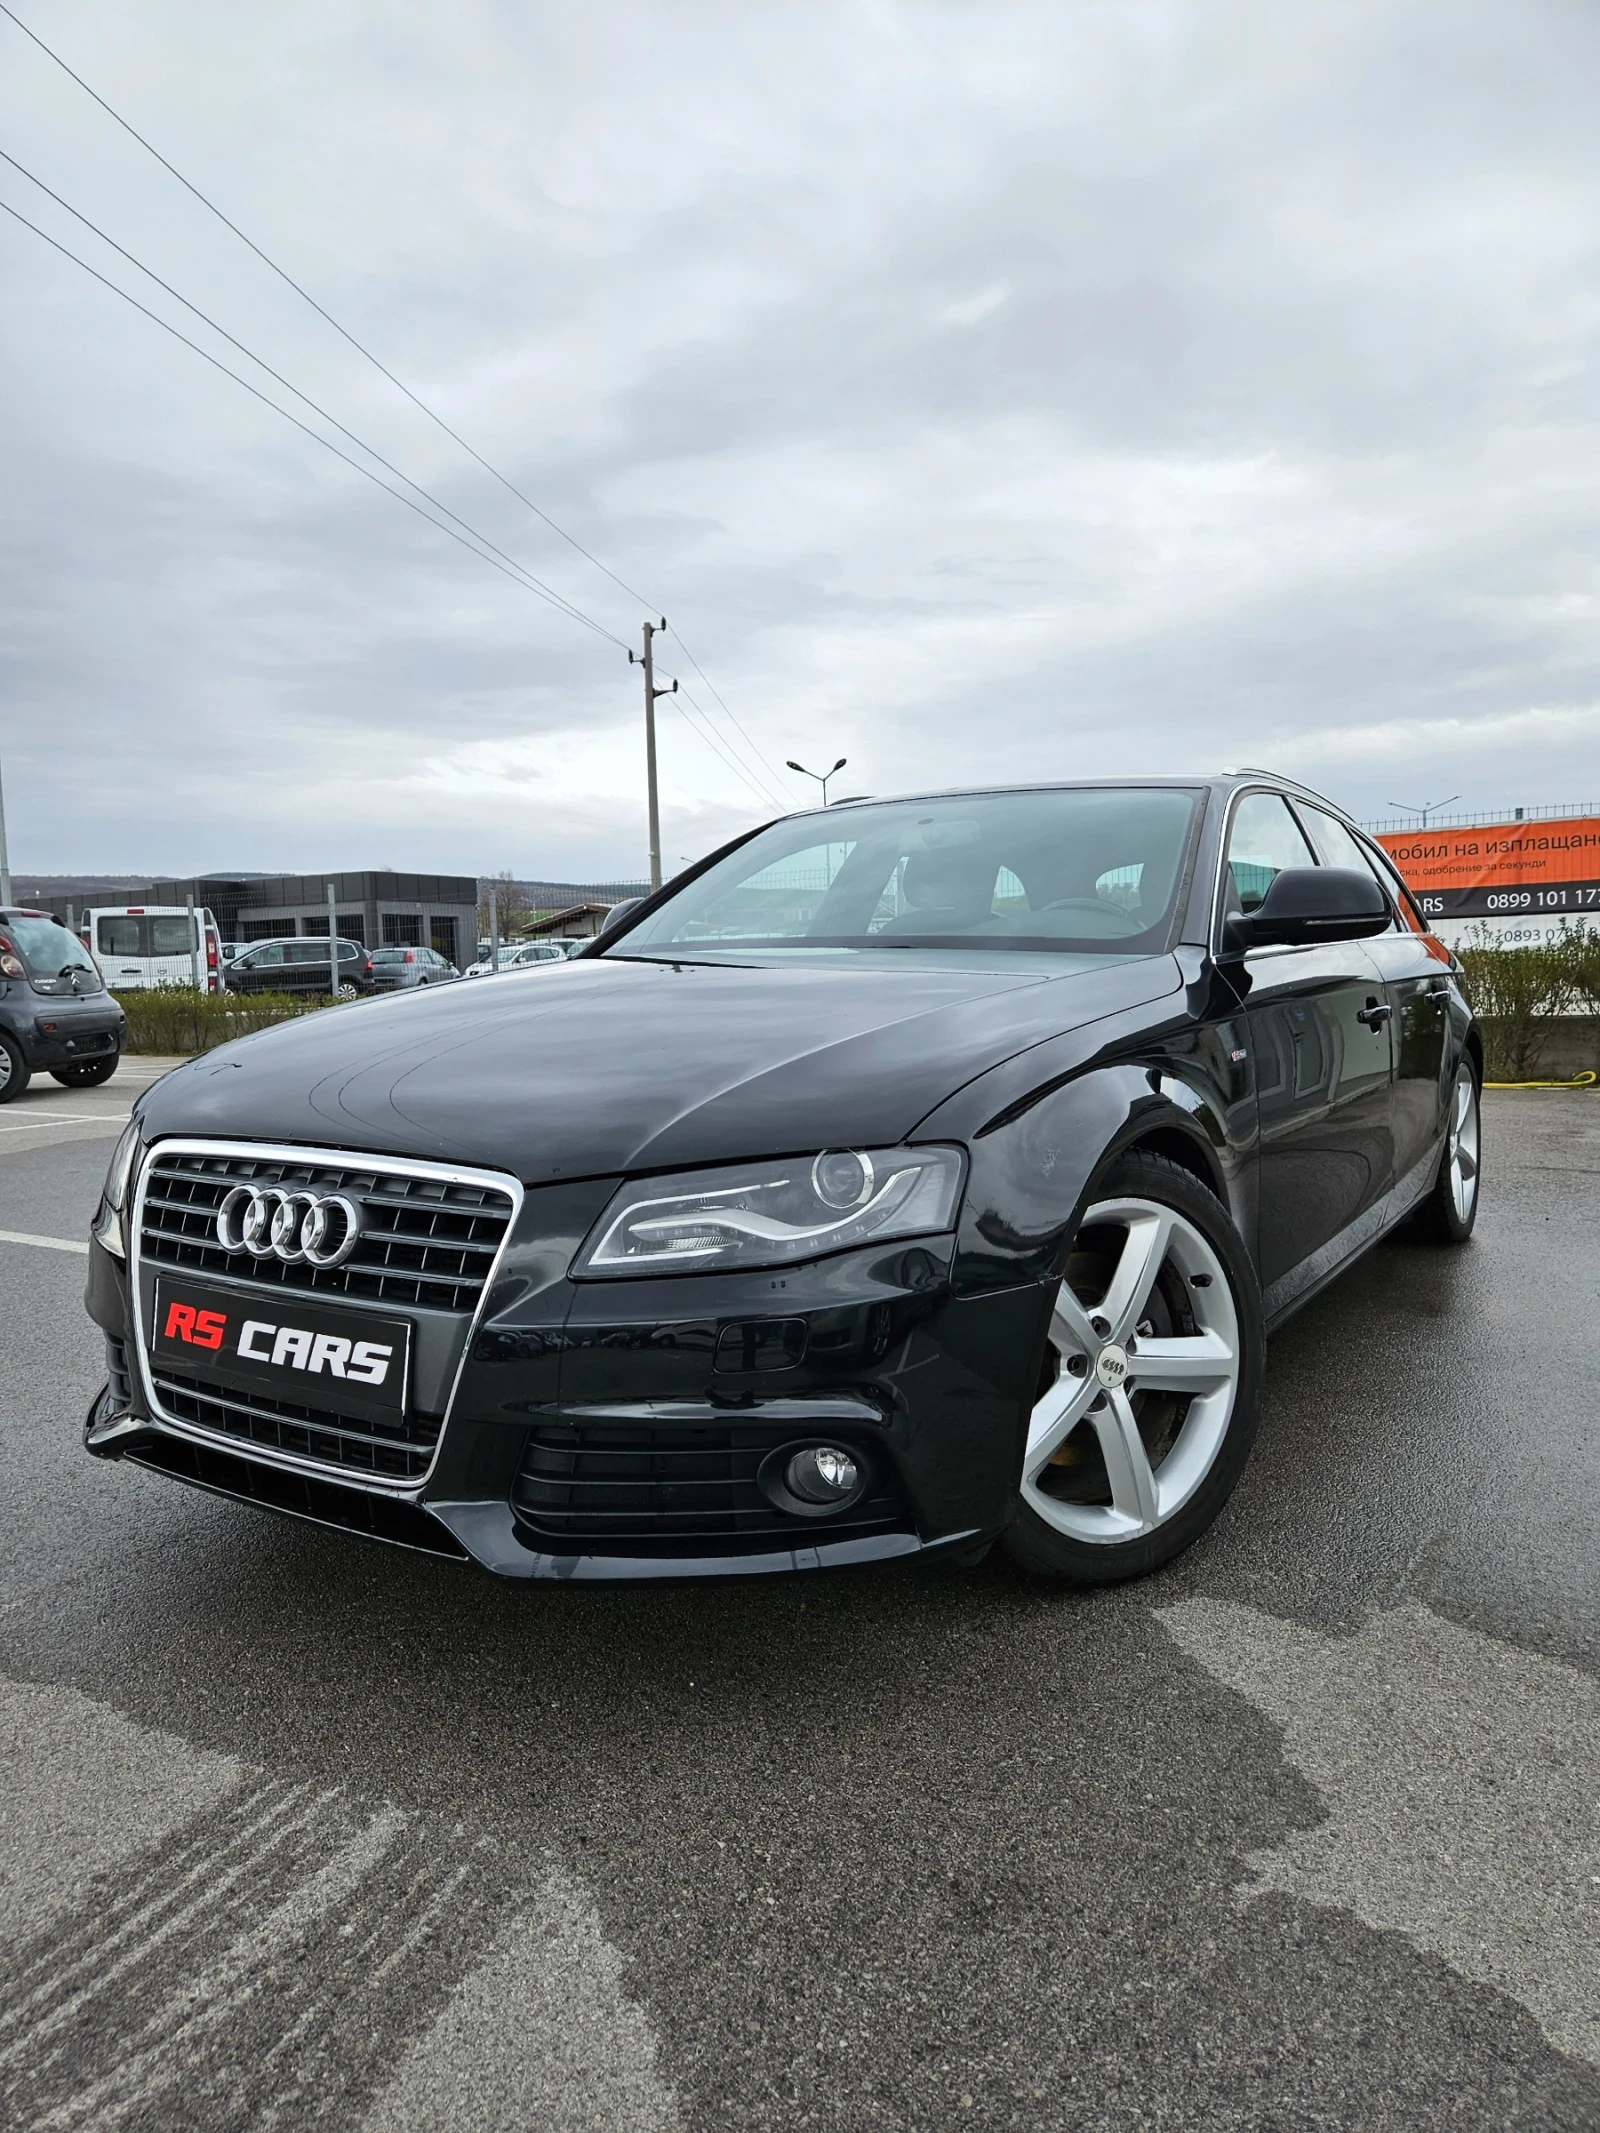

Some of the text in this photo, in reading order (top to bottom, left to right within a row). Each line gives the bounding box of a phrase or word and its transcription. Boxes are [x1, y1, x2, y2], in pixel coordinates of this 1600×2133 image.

[1455, 843, 1479, 856] на
[1486, 834, 1600, 854] изплащан
[1422, 865, 1483, 876] одобрение
[1499, 860, 1546, 871] секунди
[1487, 892, 1531, 909] 0899
[1537, 890, 1566, 906] 101
[1575, 888, 1600, 904] 17
[1504, 929, 1541, 942] 0893
[1545, 927, 1576, 943] 07
[164, 1302, 393, 1385] RS CARS
